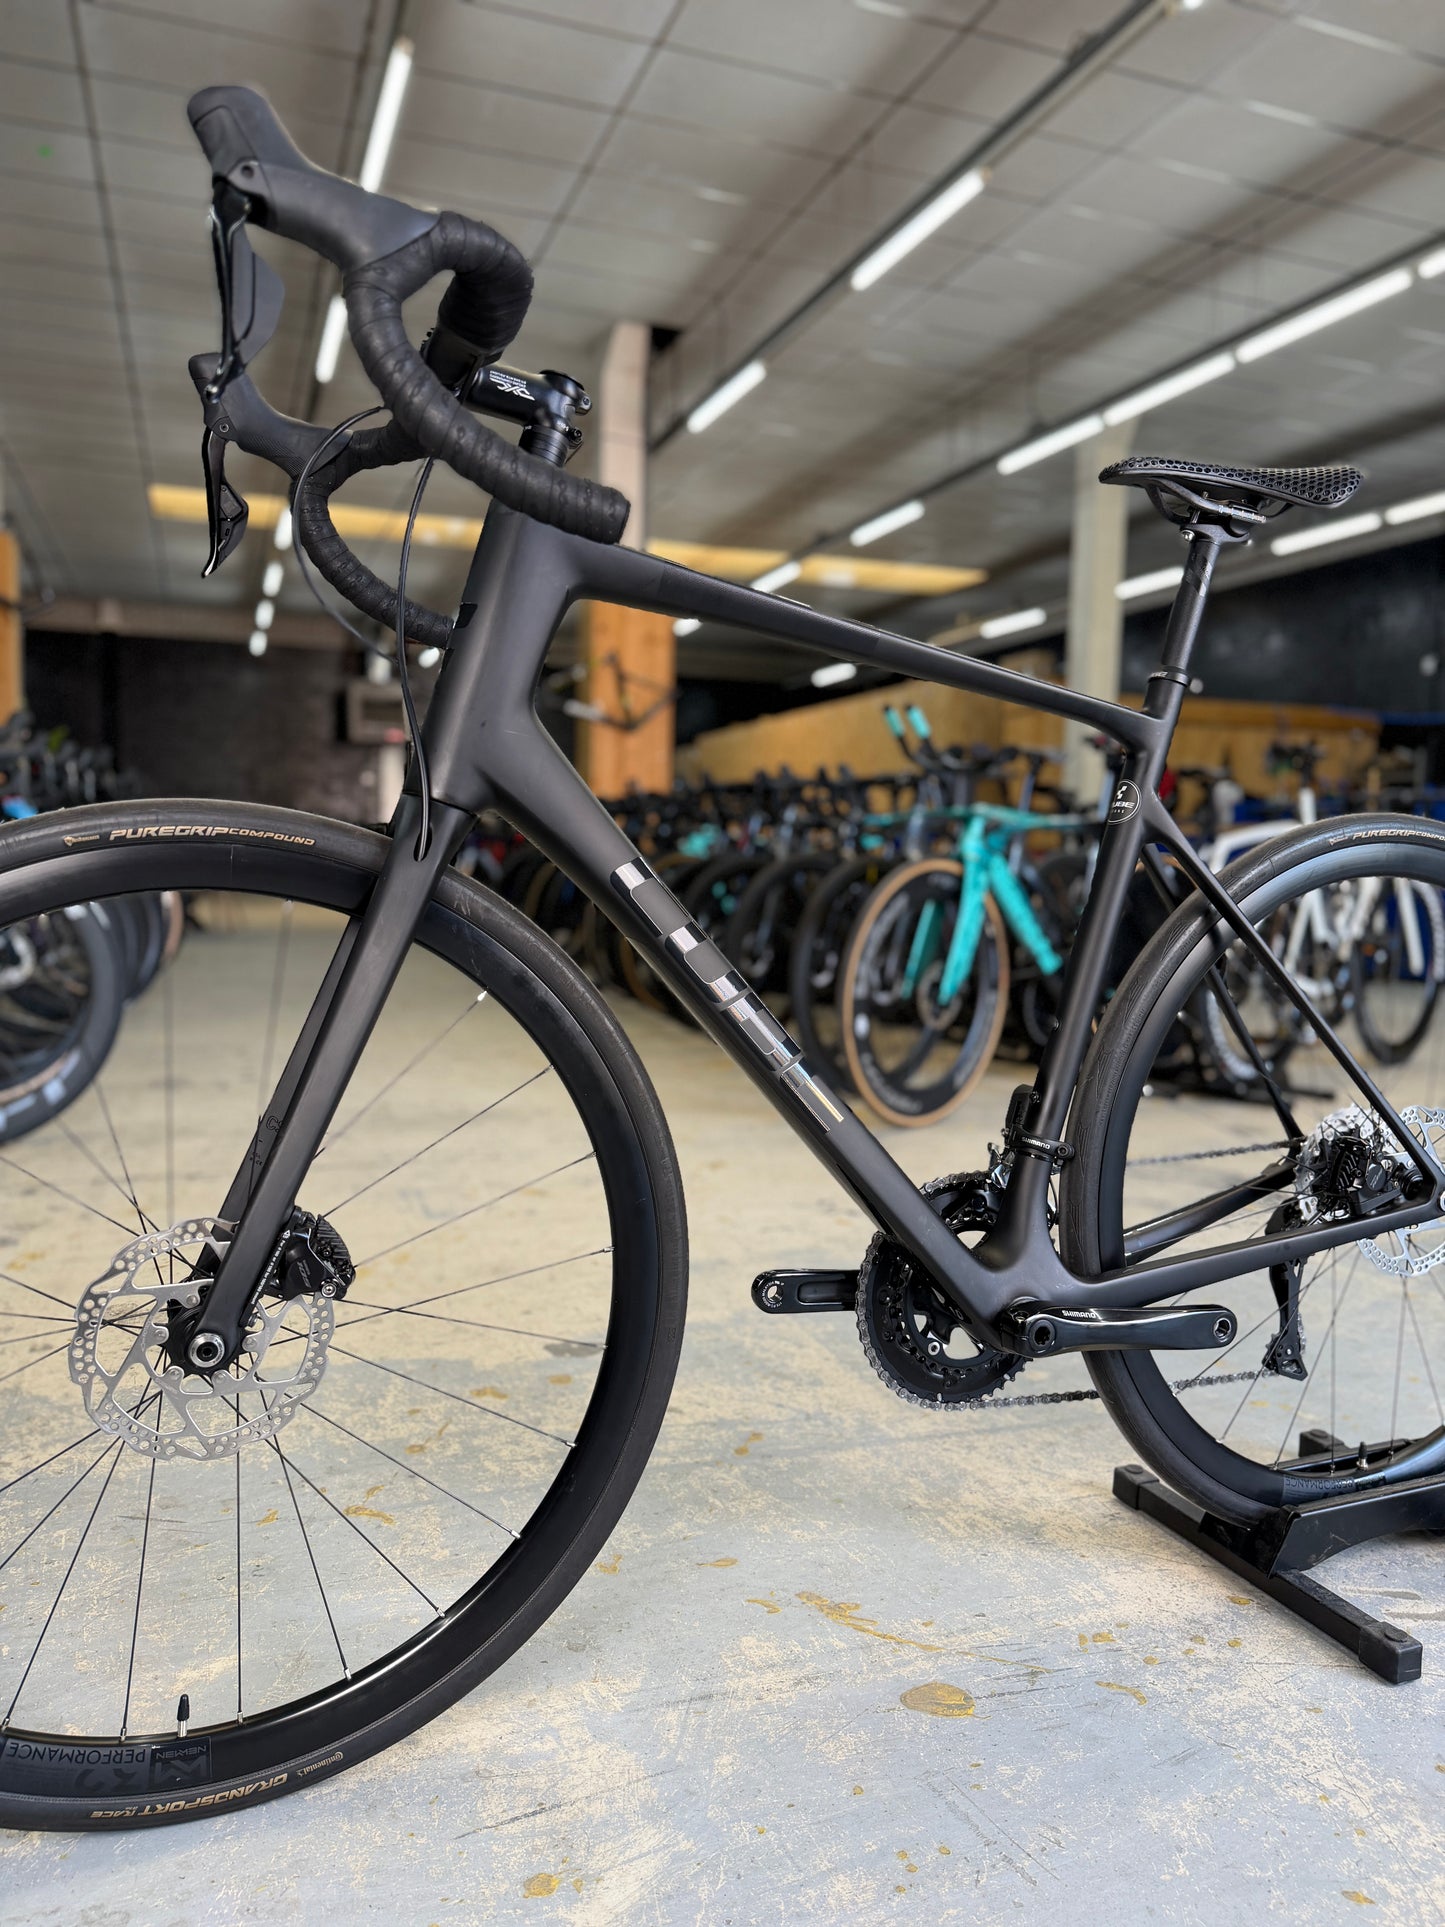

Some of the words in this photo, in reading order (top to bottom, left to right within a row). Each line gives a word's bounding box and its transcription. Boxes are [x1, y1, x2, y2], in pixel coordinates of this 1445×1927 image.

[109, 825, 230, 841] PUREGRIP
[229, 828, 316, 846] COMPOUND
[1352, 829, 1416, 840] PUREGRIP
[1021, 1137, 1051, 1150] SHIMANO
[1062, 1309, 1097, 1319] SHIMANO
[6, 1742, 146, 1765] PERFORMANCE
[136, 1773, 288, 1816] GRANDSPORT
[90, 1809, 137, 1819] RACE
